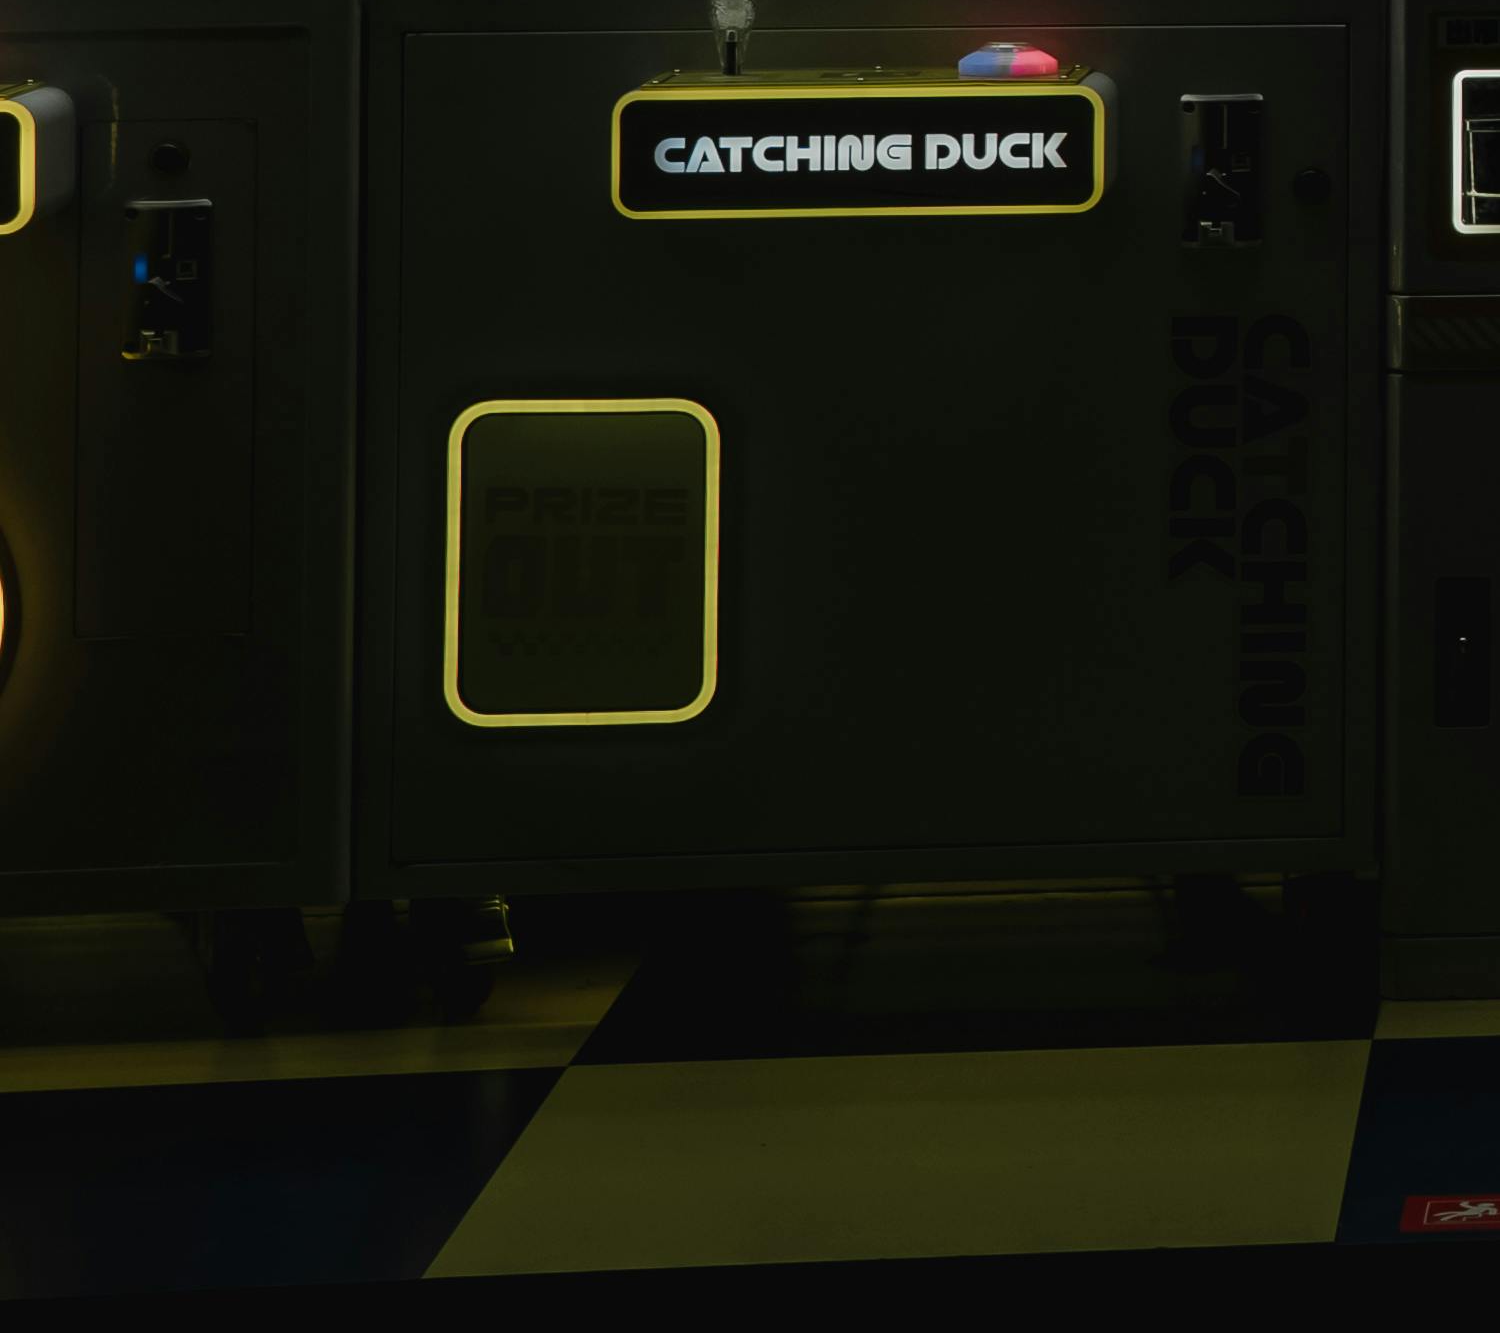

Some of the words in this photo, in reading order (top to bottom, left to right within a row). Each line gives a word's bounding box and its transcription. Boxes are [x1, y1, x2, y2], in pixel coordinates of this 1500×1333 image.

[653, 133, 914, 175] CATCHING
[924, 132, 1069, 171] DUCK
[1168, 315, 1238, 585] DUCK
[485, 486, 689, 527] PRIZE
[481, 537, 686, 621] OUT
[1237, 313, 1311, 799] CATCHING
